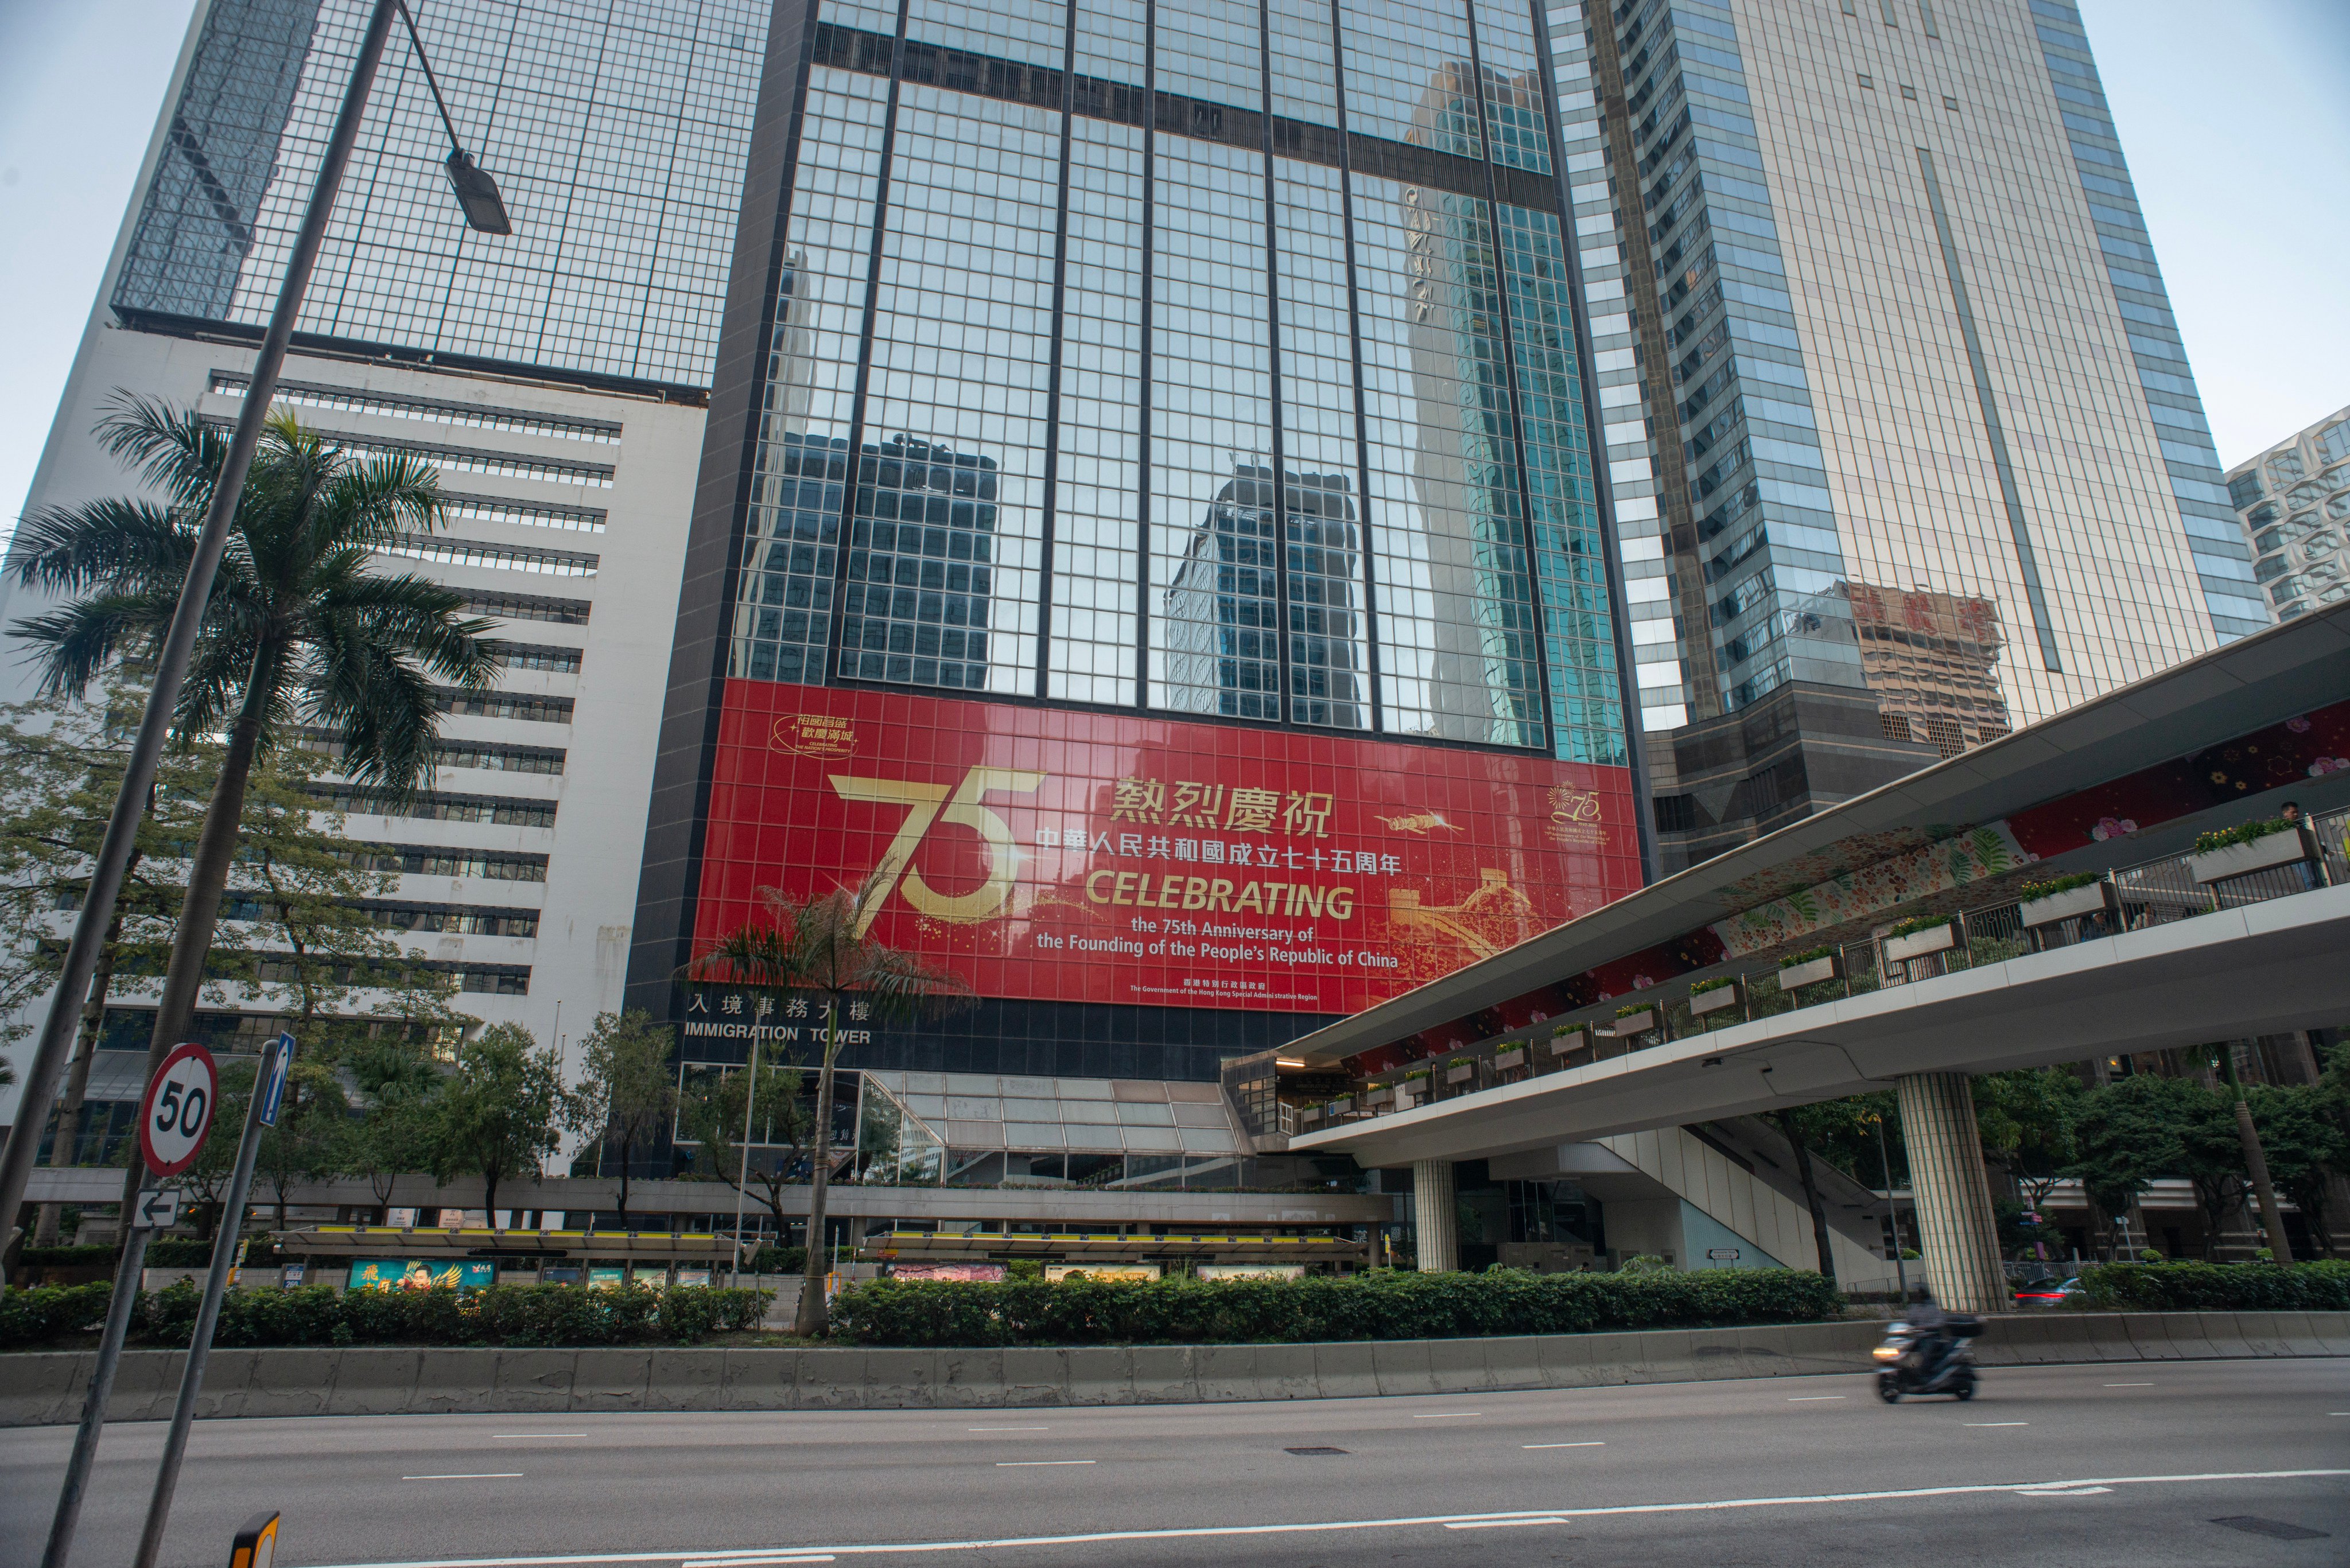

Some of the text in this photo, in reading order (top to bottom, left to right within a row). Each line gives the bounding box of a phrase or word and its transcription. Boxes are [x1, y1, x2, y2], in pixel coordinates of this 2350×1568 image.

[798, 714, 848, 729] 祖國昌盛
[801, 727, 853, 743] 歡慶滿城
[1110, 777, 1333, 838] 熱烈慶祝
[1571, 790, 1599, 821] 75
[828, 765, 1048, 940] 75
[1035, 827, 1403, 876] 中華人民共和國成立七十五周年
[1086, 869, 1354, 920] CELEBRATING
[1131, 916, 1314, 944] the 75th Anniversary of
[1036, 932, 1063, 948] the
[1070, 935, 1143, 958] Founding
[1149, 939, 1166, 955] of
[1170, 940, 1195, 956] the
[1270, 947, 1333, 966] Republic
[1338, 950, 1353, 965] of
[1358, 951, 1398, 968] China
[1143, 986, 1179, 994] Government
[1199, 989, 1214, 997] Hong
[1215, 990, 1230, 998] Kong
[1183, 978, 1265, 990] 香港特別行政區政府
[685, 1021, 871, 1044] IMMIGRATION TOWER
[156, 1080, 206, 1138] 50
[362, 1264, 379, 1281] 飛
